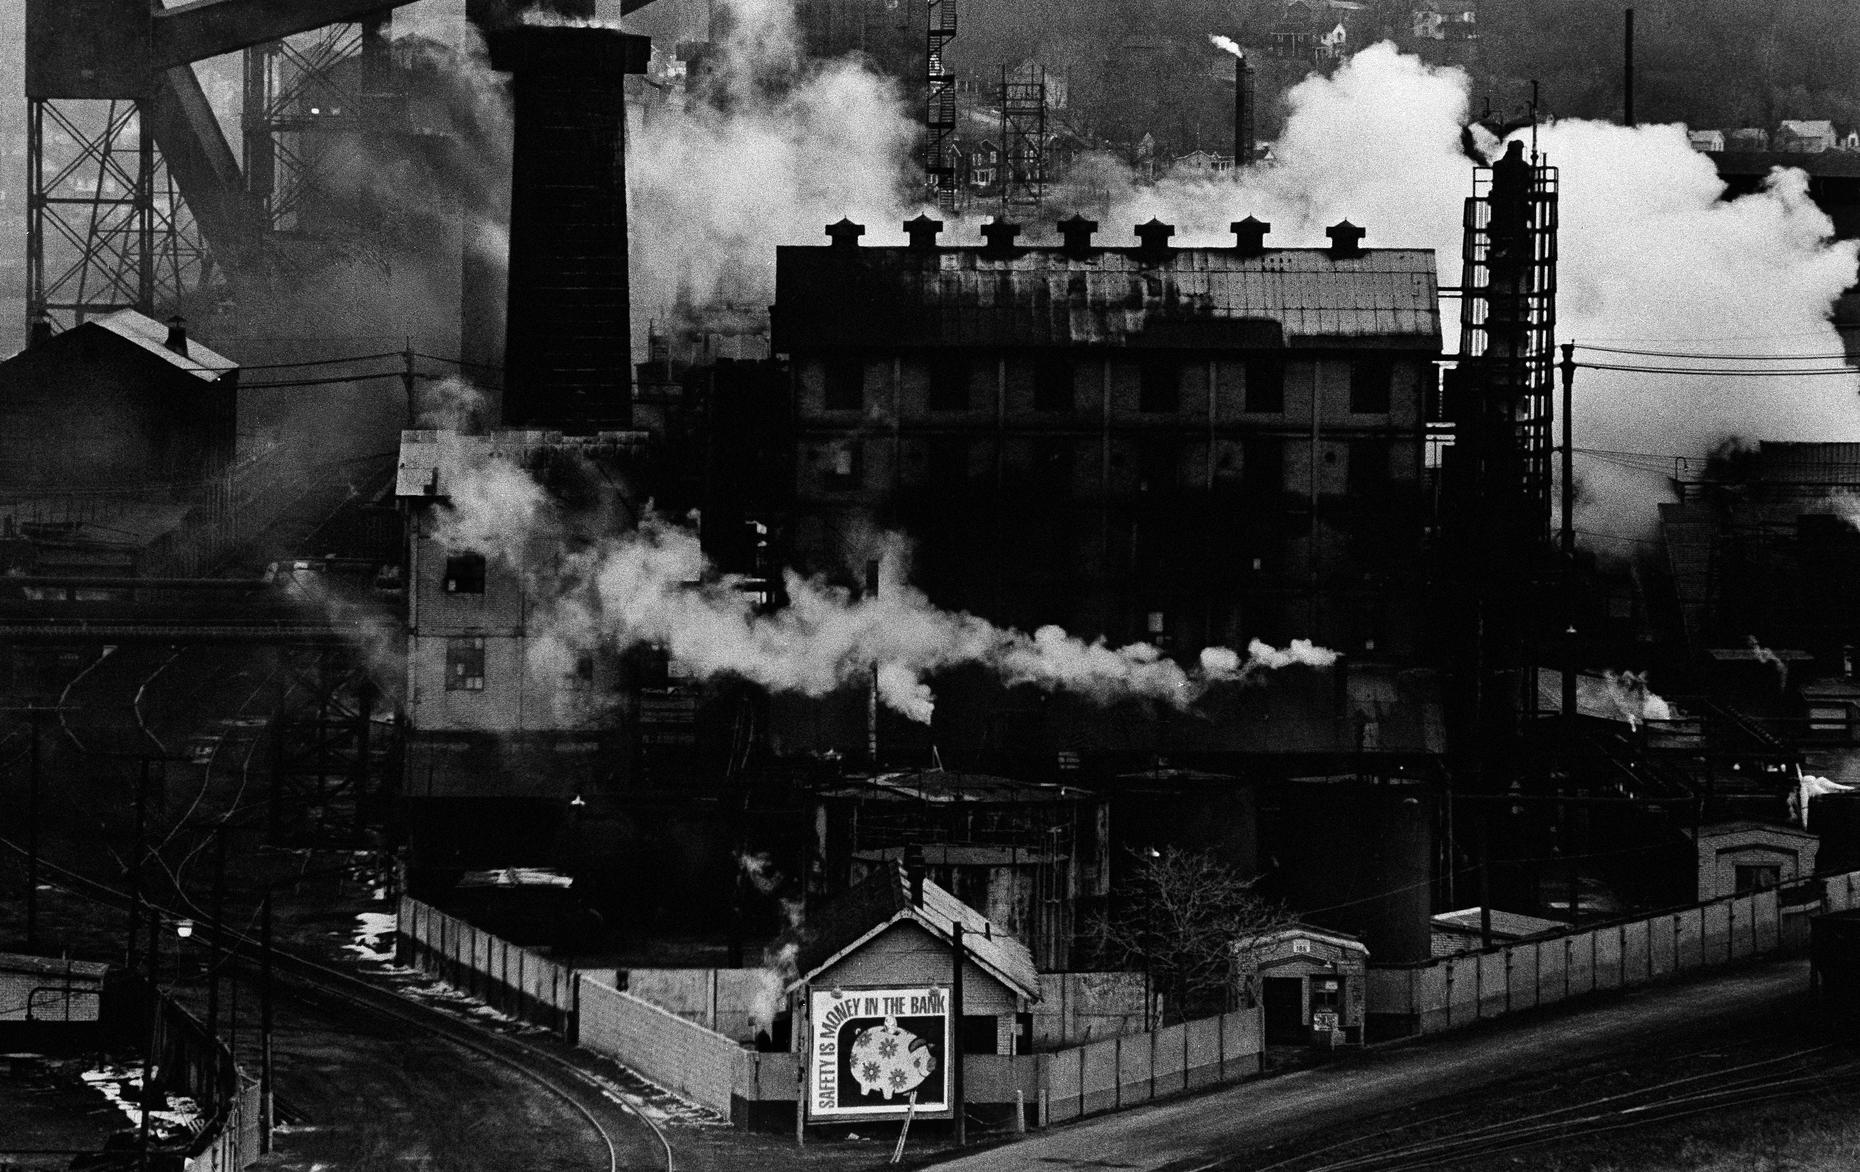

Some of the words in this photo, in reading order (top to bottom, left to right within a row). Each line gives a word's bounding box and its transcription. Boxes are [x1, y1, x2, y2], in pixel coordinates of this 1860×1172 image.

[865, 997, 878, 1015] IN
[883, 997, 905, 1015] THE
[911, 995, 945, 1014] BANK
[820, 998, 860, 1038] MONEY
[819, 1042, 835, 1056] IS
[819, 1059, 835, 1108] SAFETY
